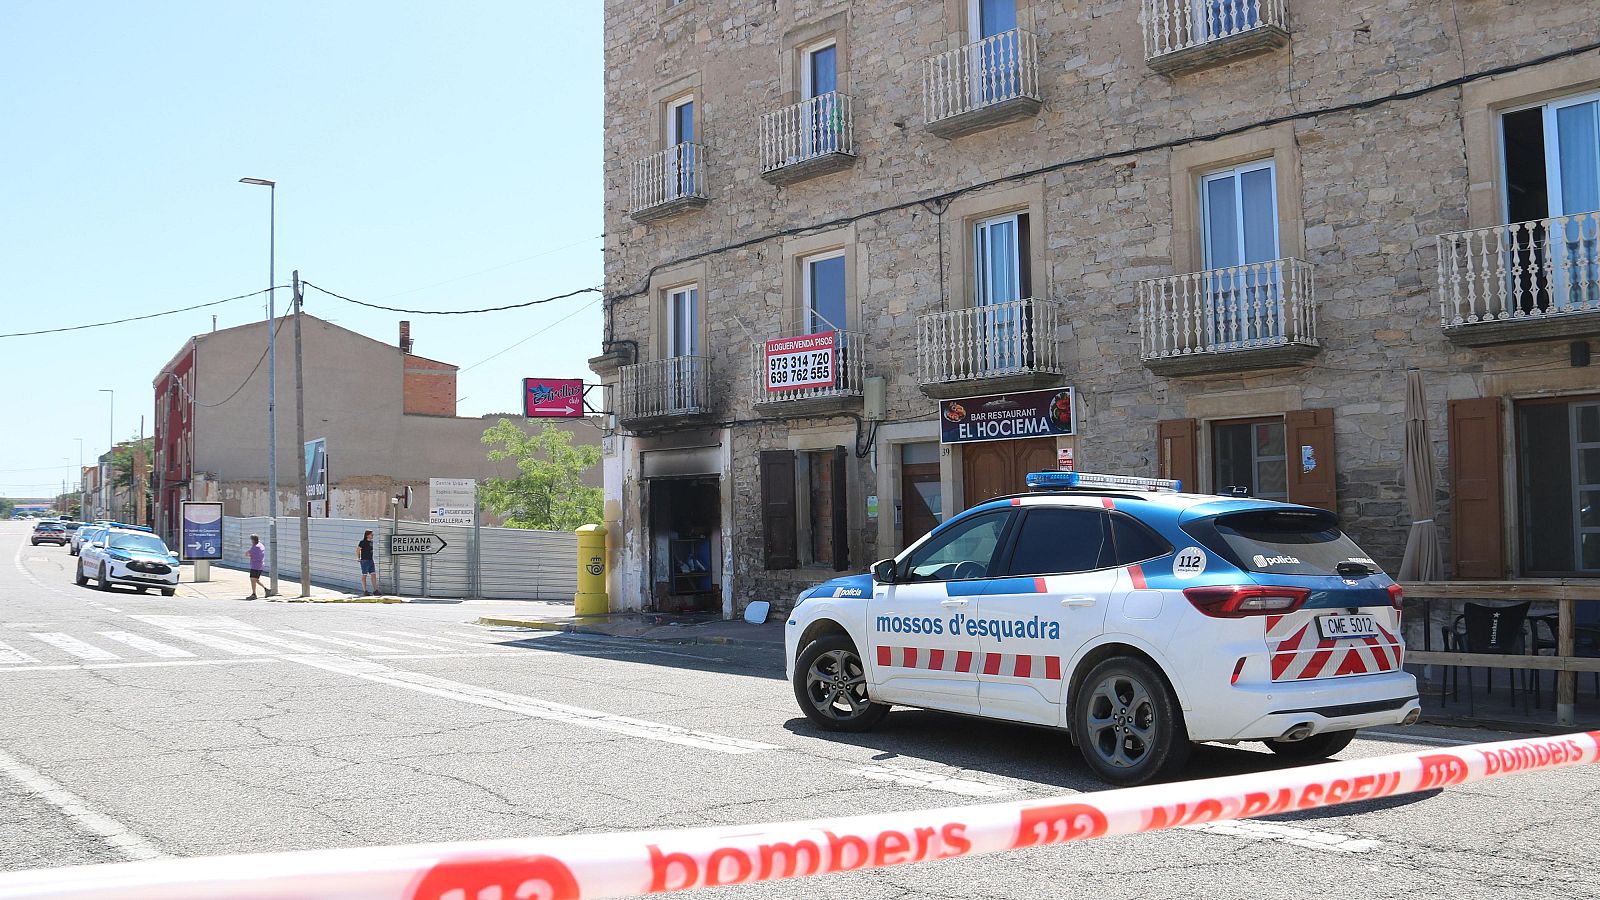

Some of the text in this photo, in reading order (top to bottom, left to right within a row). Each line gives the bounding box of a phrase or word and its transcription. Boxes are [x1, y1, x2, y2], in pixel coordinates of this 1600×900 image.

[768, 336, 833, 352] LLOGUER/VENDA PISOS
[770, 352, 830, 371] 973 314 720
[770, 365, 830, 384] 639 762 555
[533, 384, 581, 406] Estrellas
[971, 408, 1037, 421] BAR RESTAURANT
[959, 416, 1050, 439] EL HOCIEMA
[942, 448, 950, 457] 39
[1178, 555, 1201, 568] 112
[1265, 556, 1300, 565] policia
[839, 587, 862, 598] policia
[876, 613, 1060, 642] mossos d'esquadra
[1327, 617, 1374, 634] CME 5012
[646, 819, 972, 893] bombers
[1480, 739, 1583, 777] bombers
